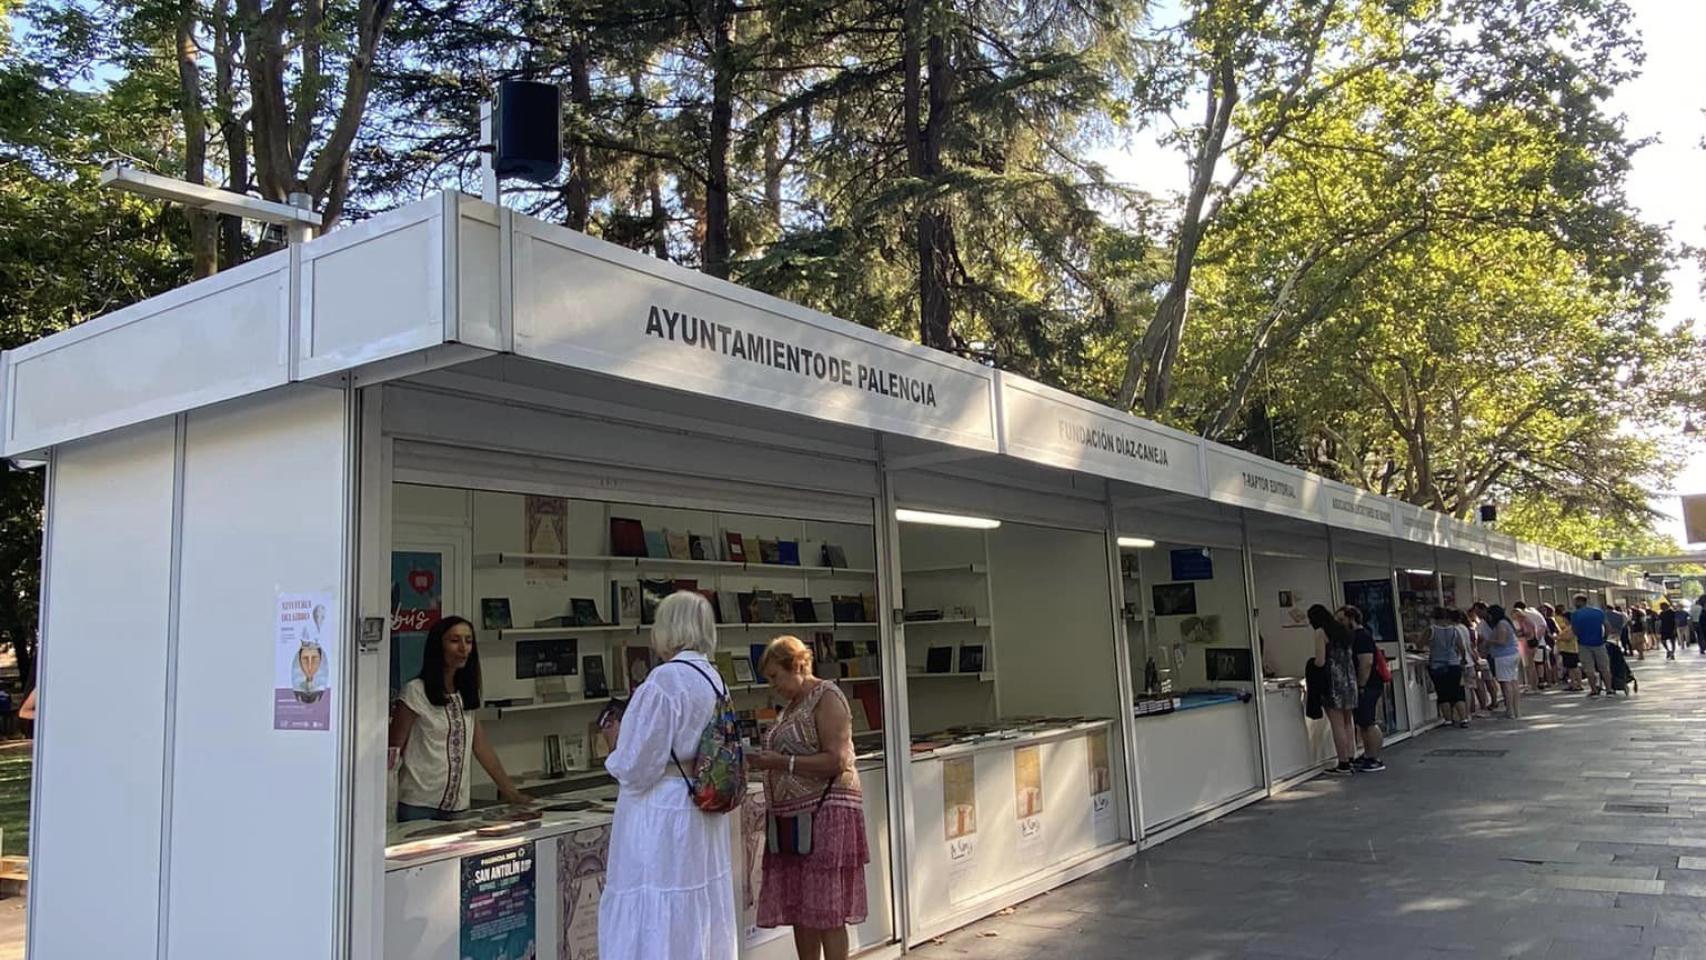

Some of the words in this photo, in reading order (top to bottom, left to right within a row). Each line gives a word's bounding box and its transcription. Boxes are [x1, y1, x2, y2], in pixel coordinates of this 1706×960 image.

[857, 364, 937, 408] PALENCIA
[1058, 419, 1115, 452] FUNDACIÓN
[1116, 433, 1169, 467] DÍAZ-CANEJA
[475, 868, 490, 883] SAN
[491, 860, 520, 880] ANTOLÍN
